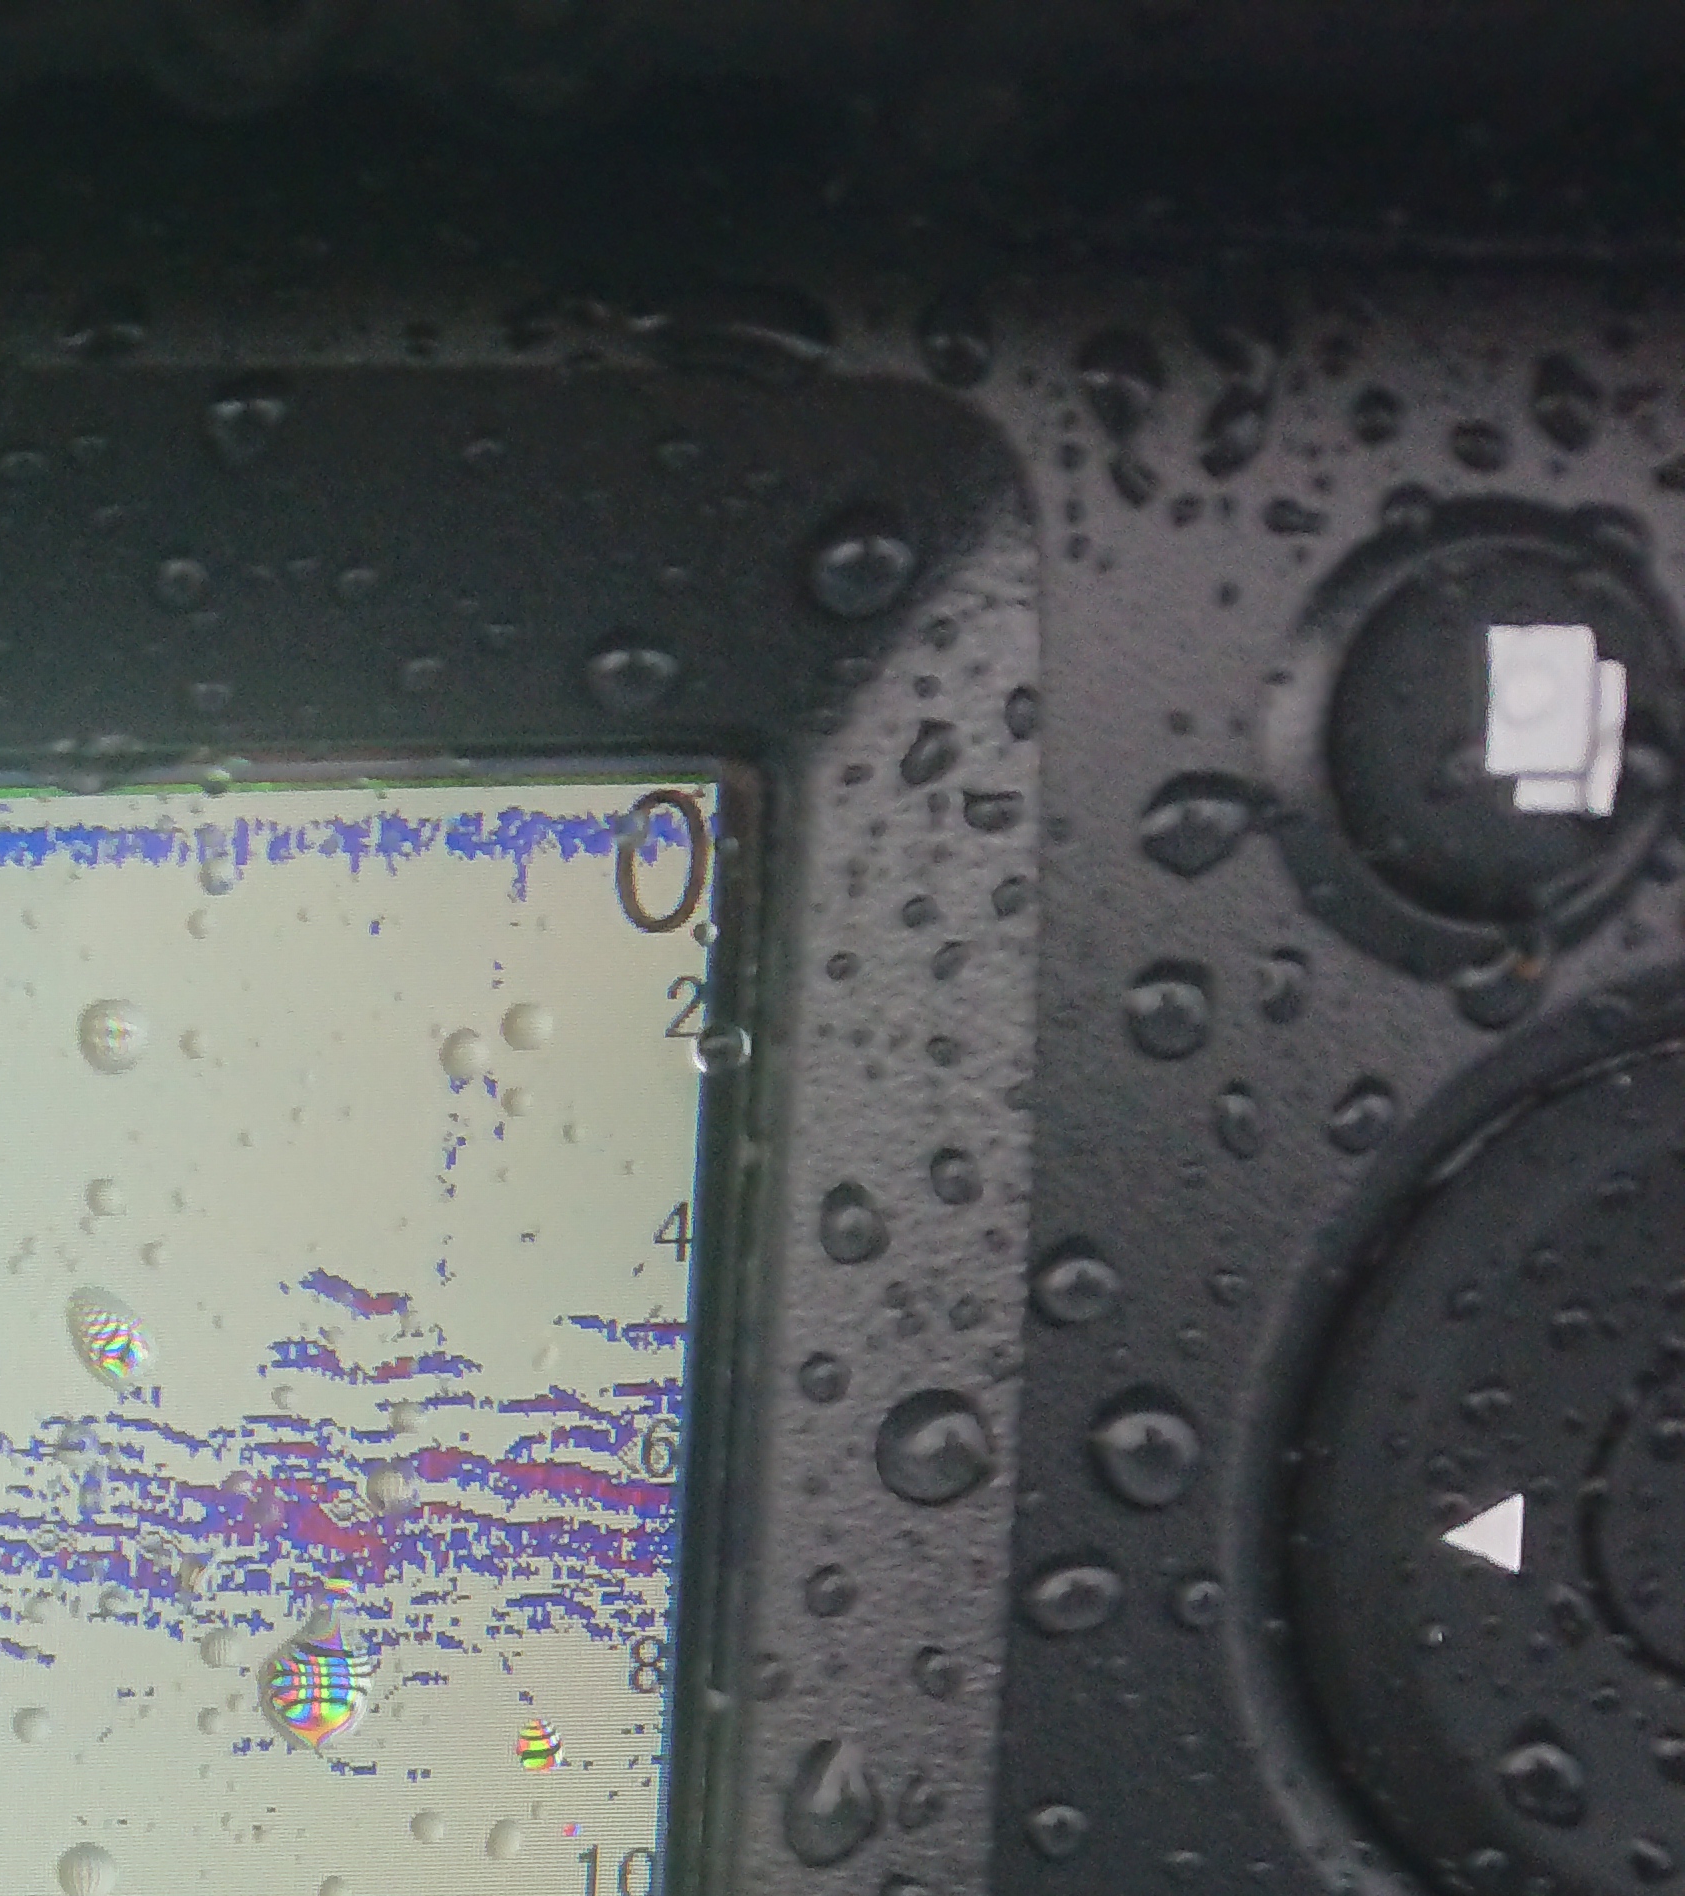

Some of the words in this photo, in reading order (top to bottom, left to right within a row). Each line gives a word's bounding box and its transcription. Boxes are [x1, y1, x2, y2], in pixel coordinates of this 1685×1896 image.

[617, 789, 706, 933] 0
[664, 975, 707, 1039] 2
[653, 1201, 693, 1262] 4
[640, 1417, 680, 1479] 6
[630, 1635, 664, 1693] 8
